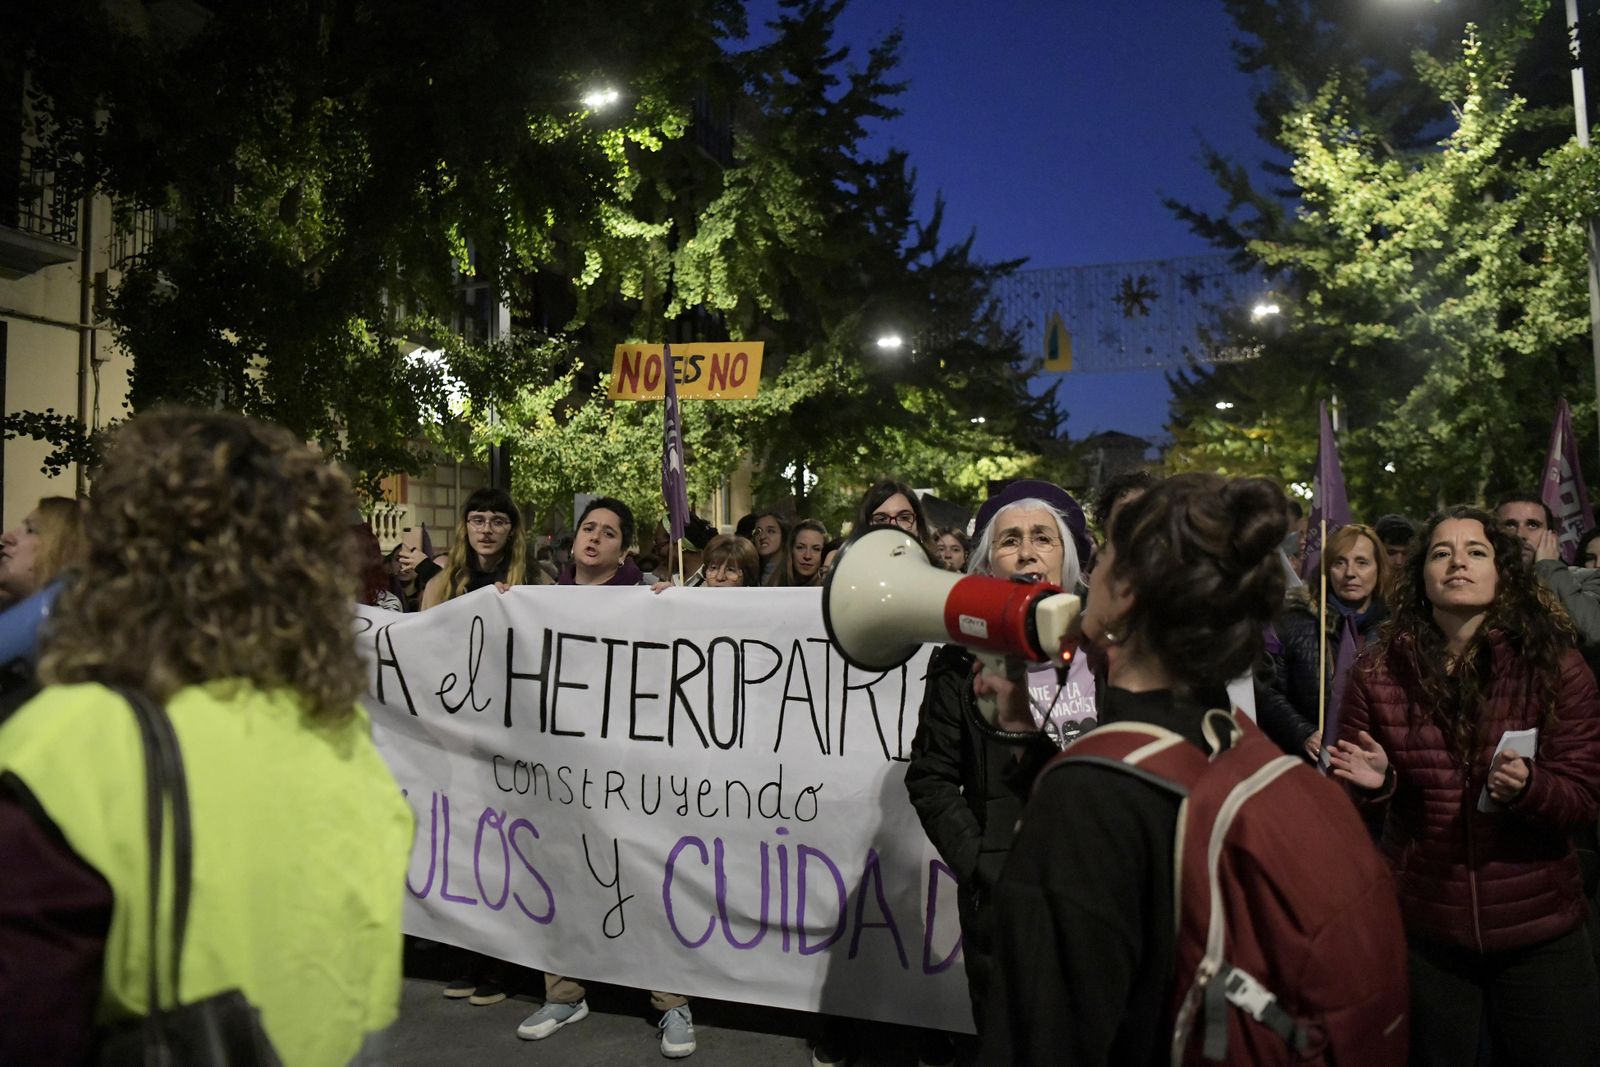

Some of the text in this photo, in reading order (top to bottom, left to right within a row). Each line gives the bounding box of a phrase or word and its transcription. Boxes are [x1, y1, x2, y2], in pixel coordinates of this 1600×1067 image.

[617, 351, 749, 394] NO ES NO
[354, 616, 929, 762] A el HETEROPATRI
[1066, 681, 1081, 700] LA
